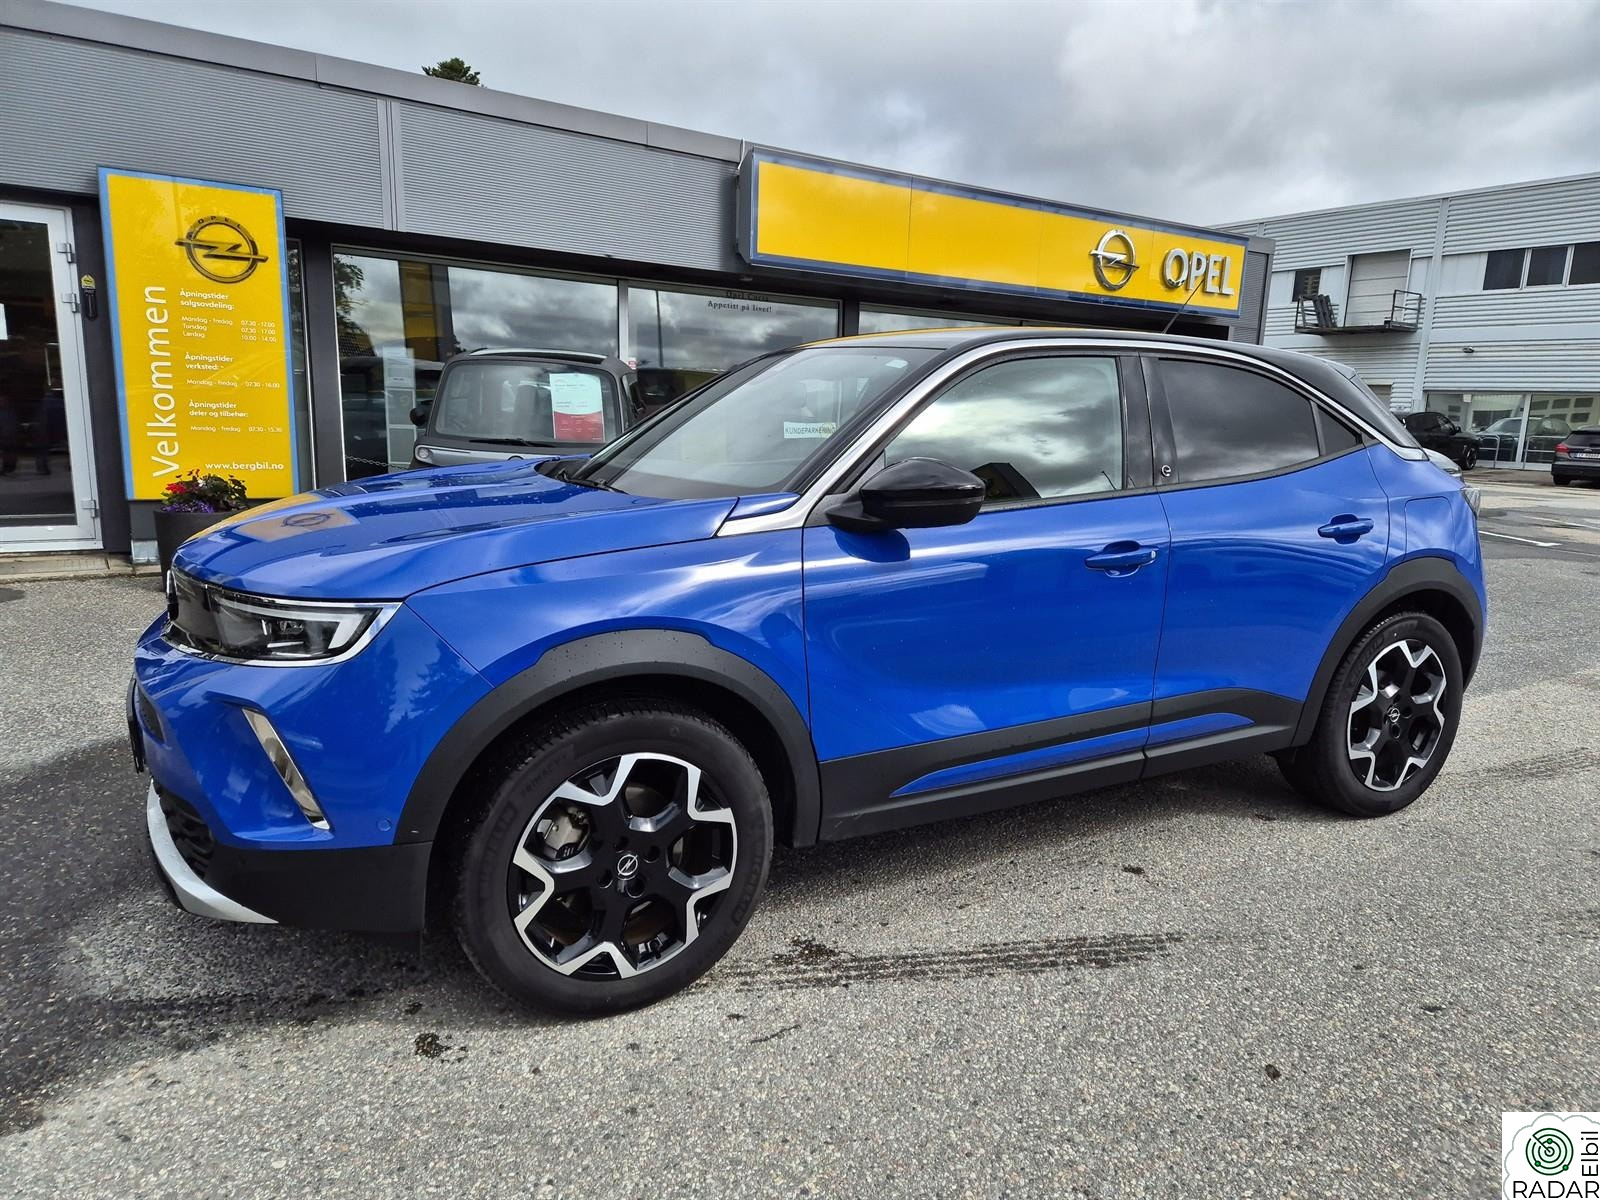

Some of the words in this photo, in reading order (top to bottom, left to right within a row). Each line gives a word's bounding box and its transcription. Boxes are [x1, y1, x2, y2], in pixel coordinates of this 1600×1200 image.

[1163, 247, 1235, 296] OPEL
[179, 288, 229, 300] Åpningstider
[707, 299, 739, 310] Appetitt
[182, 316, 208, 324] Mandag
[185, 352, 233, 363] Åpningstider
[144, 286, 180, 477] Velkommen
[188, 399, 237, 410] Åpningstider
[205, 461, 284, 471] www.bergbil.no
